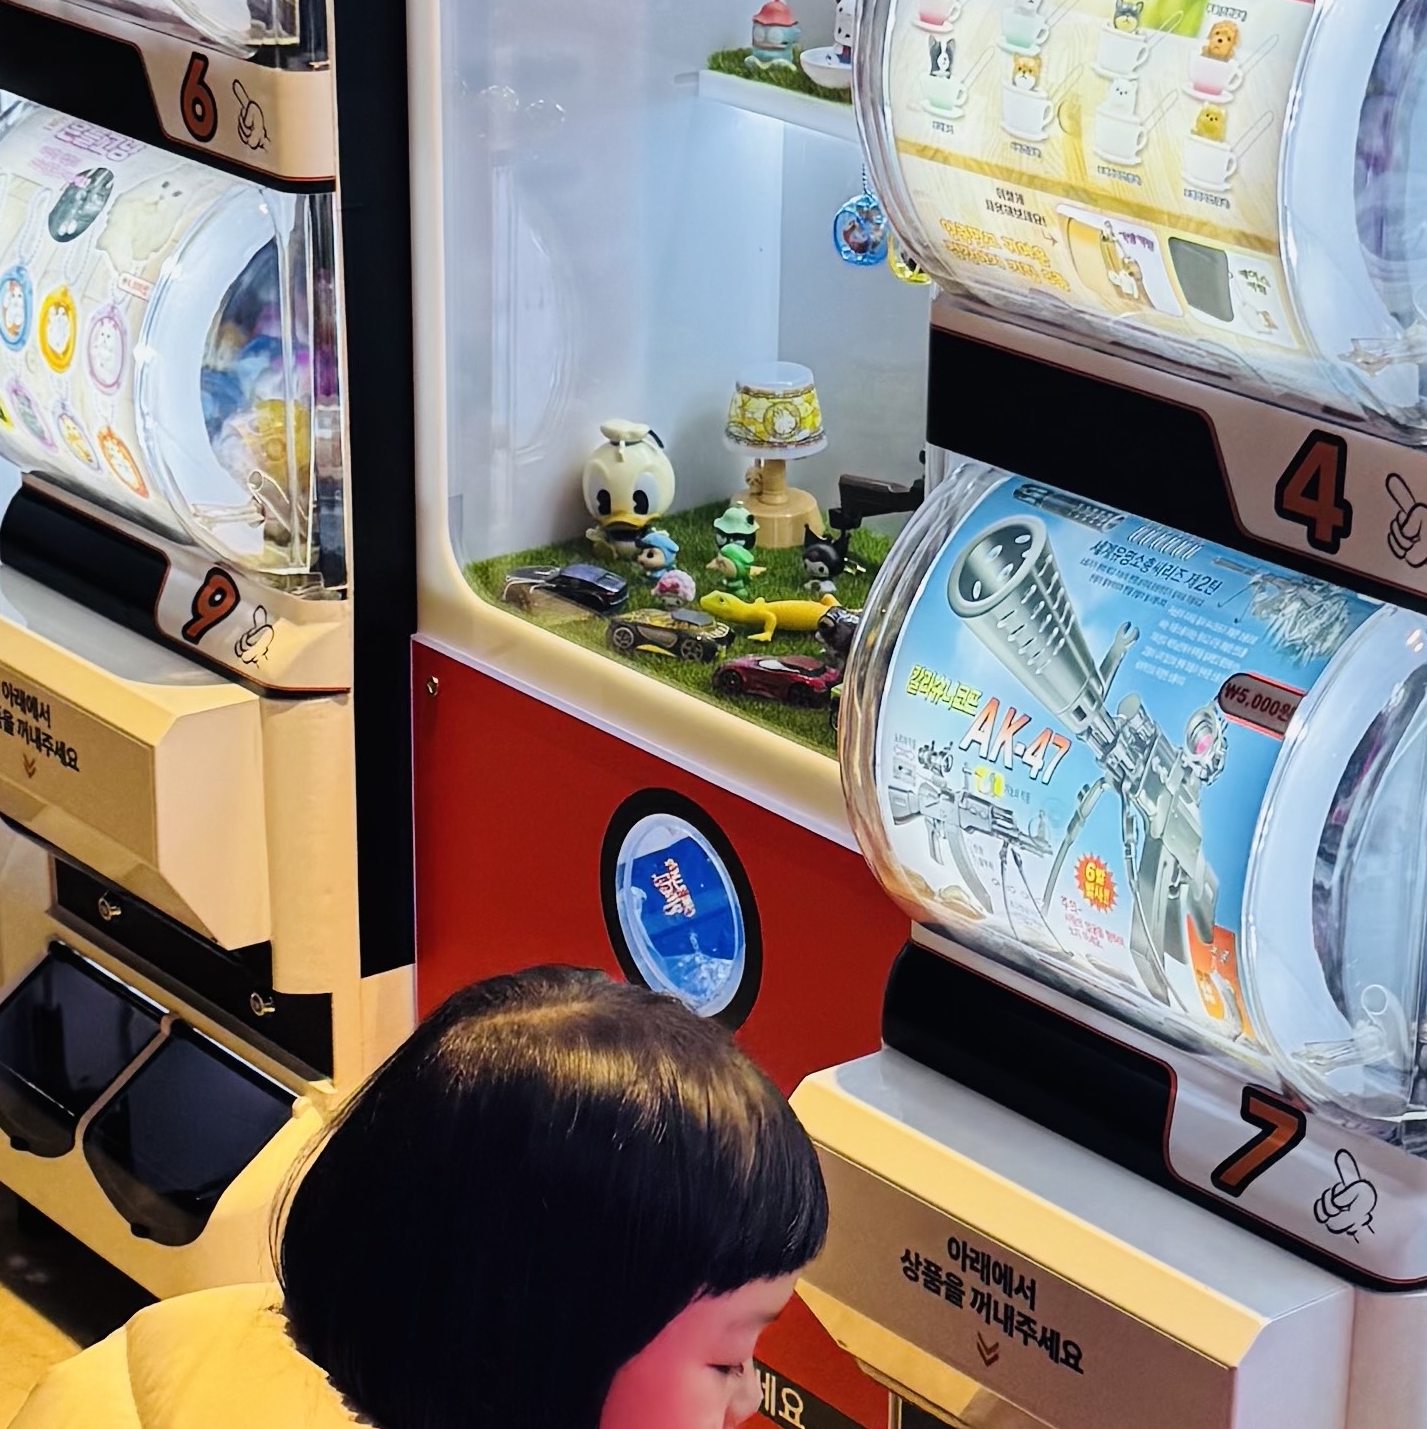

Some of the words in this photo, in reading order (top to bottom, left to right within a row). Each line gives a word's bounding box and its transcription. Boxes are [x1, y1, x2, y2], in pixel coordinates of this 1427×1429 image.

[180, 51, 218, 142] 6
[1274, 429, 1354, 555] 4
[180, 566, 241, 644] 9
[1, 681, 52, 727] 아래에서
[16, 718, 80, 773] 꺼내주세요
[958, 696, 1073, 785] AK-47
[1210, 1083, 1307, 1199] 7
[899, 1247, 966, 1306] 상품을
[970, 1287, 1085, 1375] 꺼내주세요
[945, 1235, 1038, 1305] 아래에서
